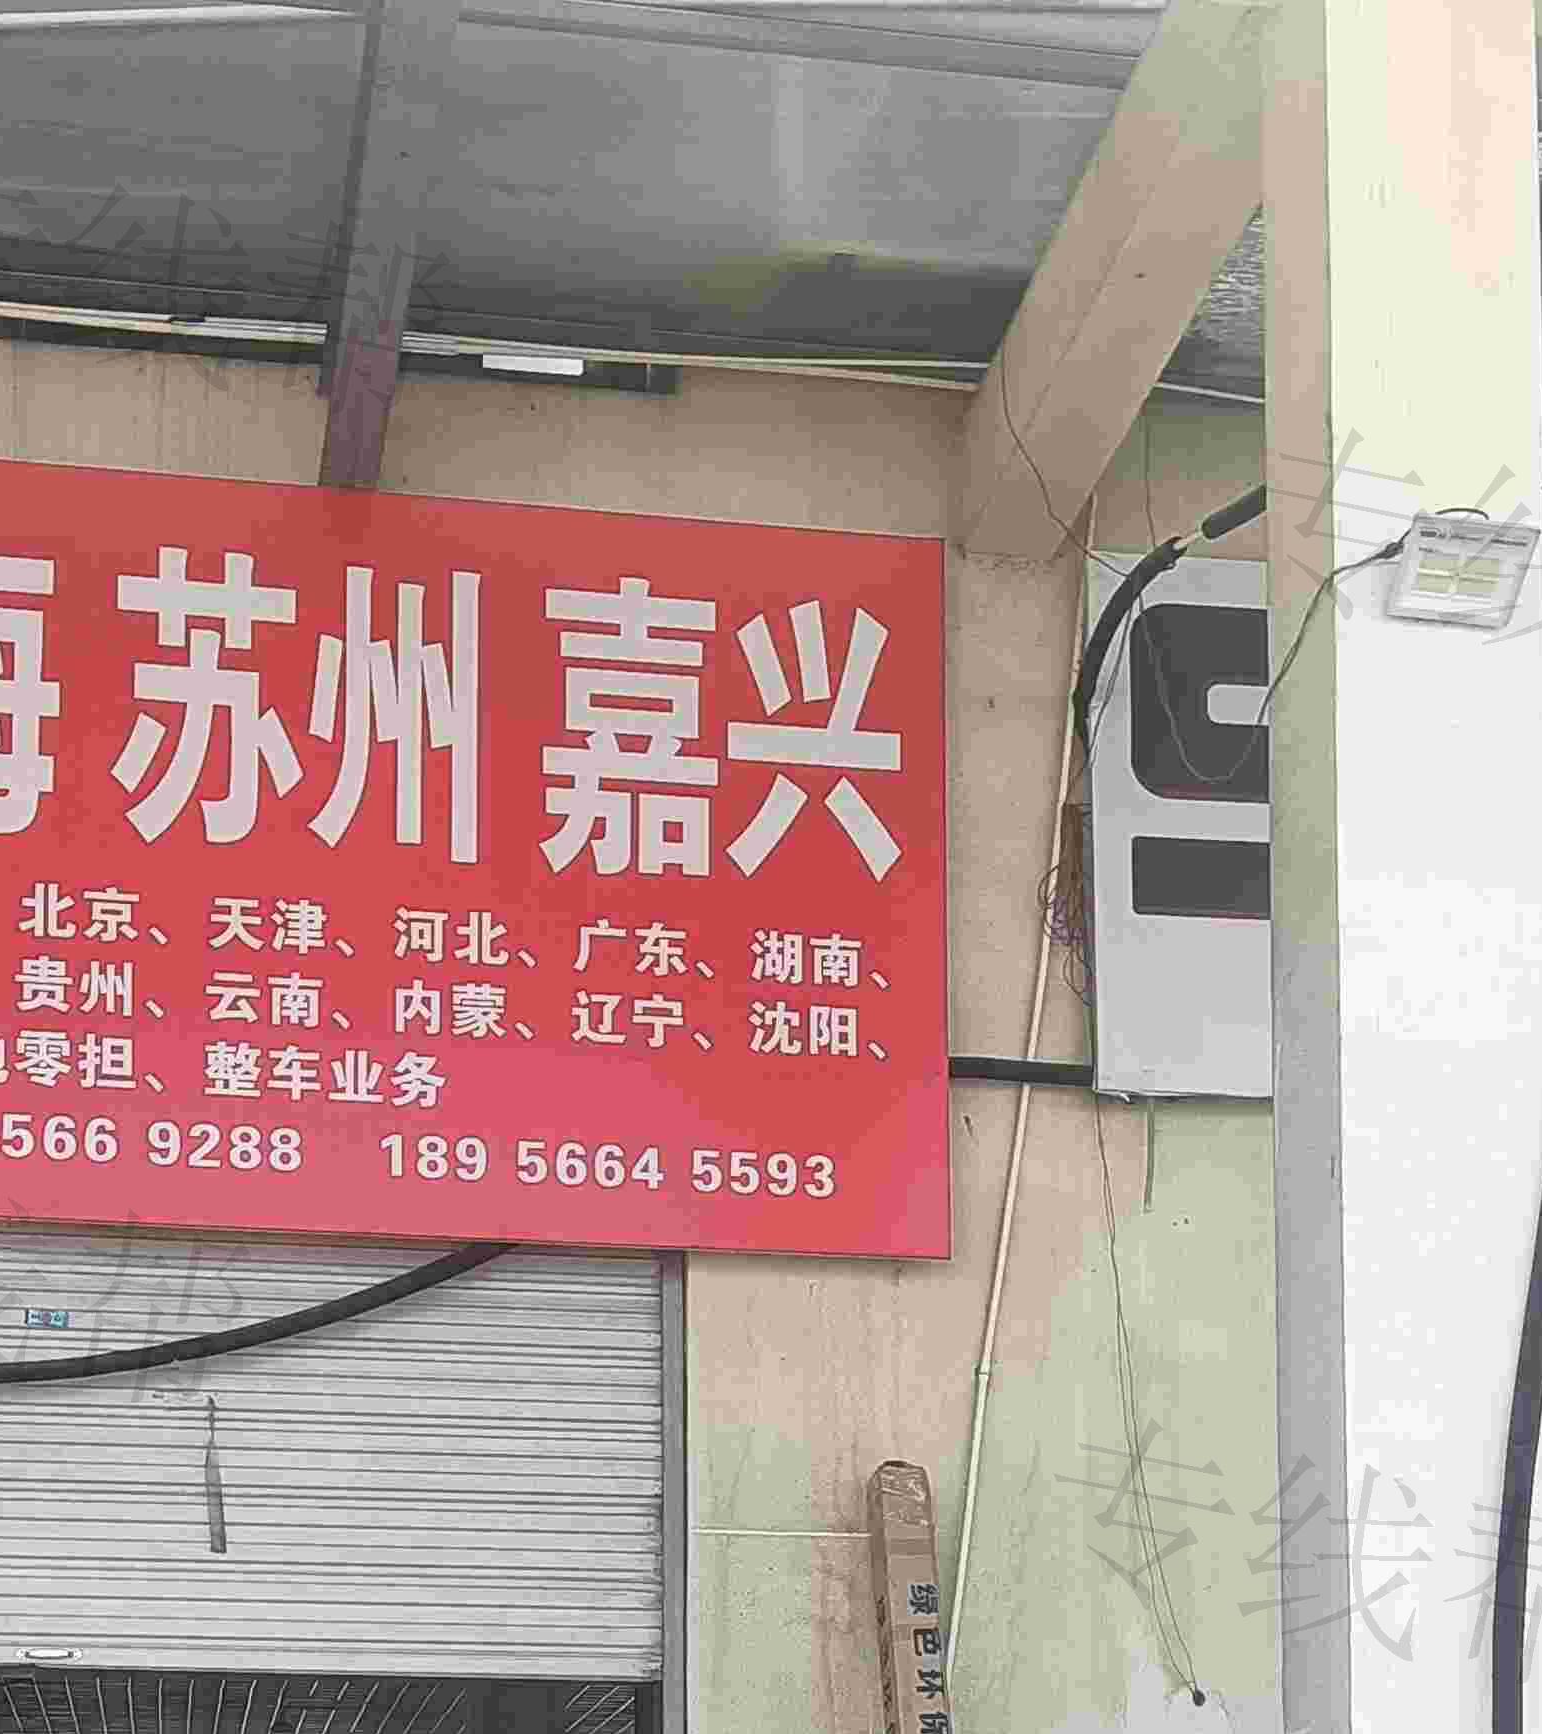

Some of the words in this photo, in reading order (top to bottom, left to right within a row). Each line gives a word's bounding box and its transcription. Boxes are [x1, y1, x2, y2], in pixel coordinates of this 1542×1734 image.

[110, 545, 481, 864] 苏州
[539, 578, 903, 880] 嘉兴
[146, 1119, 305, 1175] 9288
[379, 1130, 489, 1184] 189
[515, 1139, 666, 1192] 5664
[690, 1149, 837, 1201] 5593
